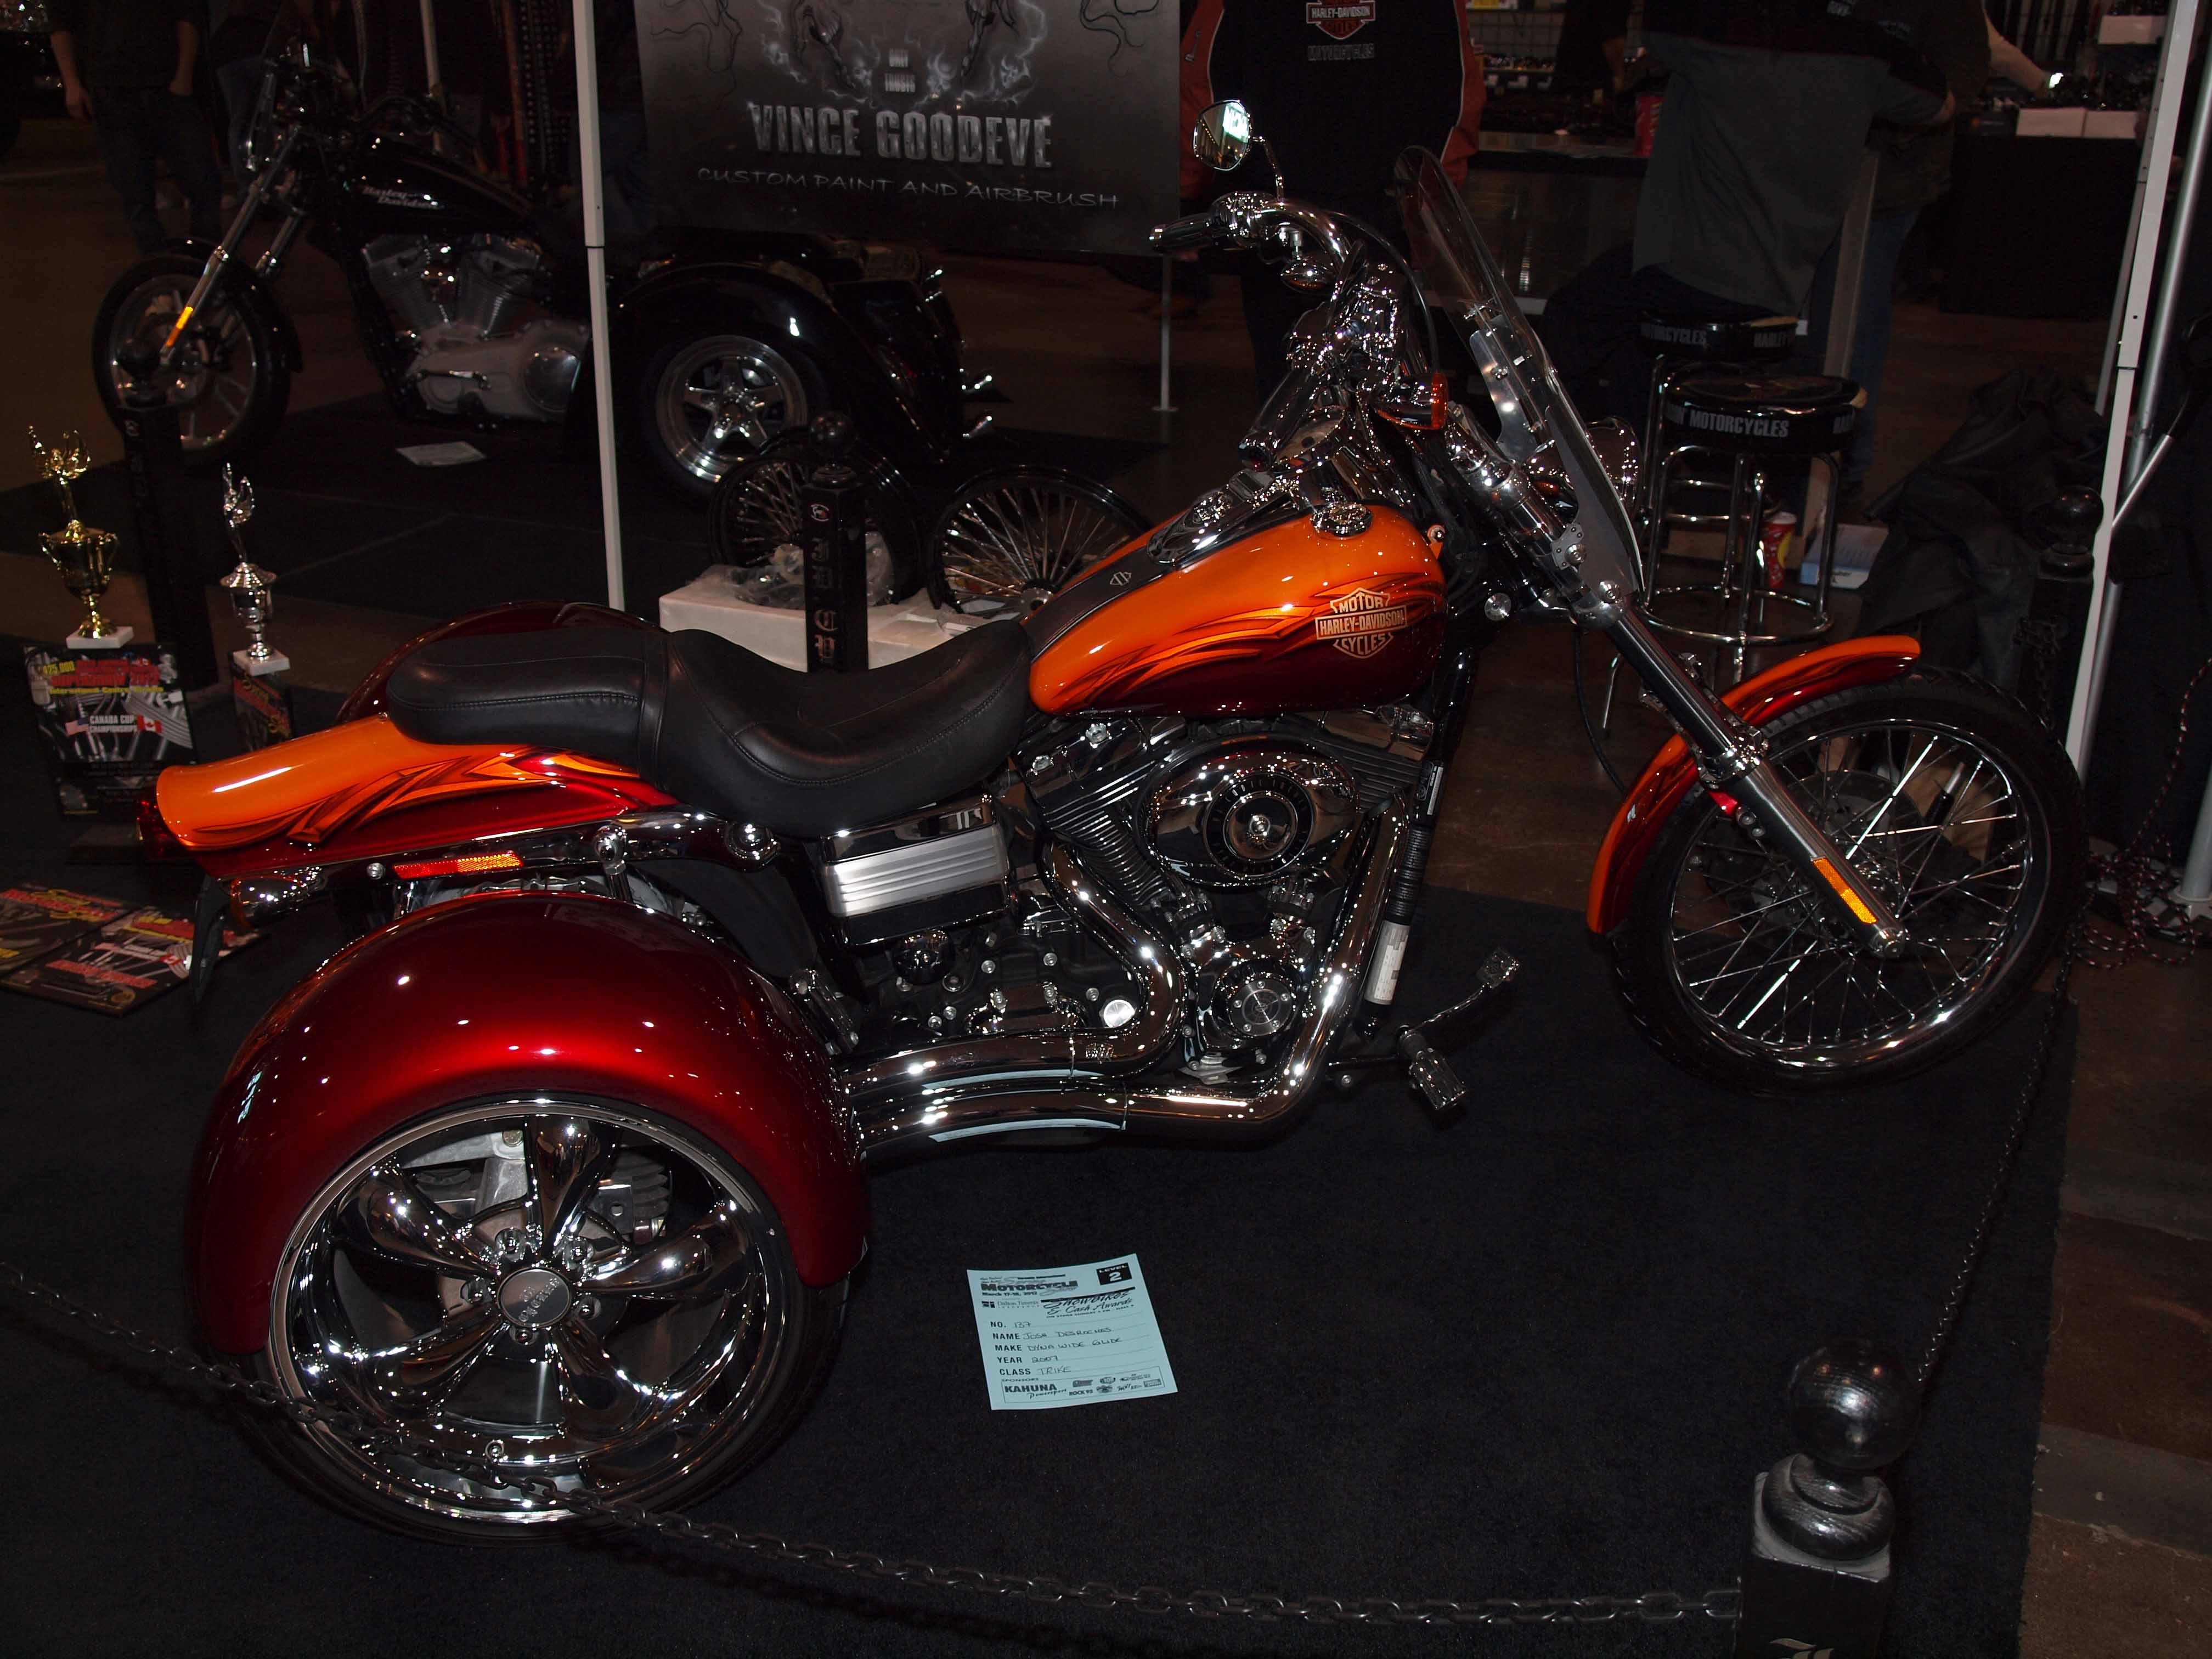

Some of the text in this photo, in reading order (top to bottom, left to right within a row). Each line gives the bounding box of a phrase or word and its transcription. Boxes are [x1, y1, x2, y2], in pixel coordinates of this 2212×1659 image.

[748, 103, 1052, 168] VINCE GOODEVE
[697, 167, 1119, 208] CUSTOM PAINT AND AIRBRUSH
[1689, 410, 1791, 438] MOTORCYCLES
[1339, 591, 1384, 613] MOTOR
[1319, 609, 1404, 636] HARLEY-DAVIDSON
[1341, 633, 1386, 655] CYCLES
[1109, 1272, 1122, 1282] 2
[1065, 1305, 1090, 1313] Cash
[1093, 1297, 1132, 1311] Awards
[1092, 1338, 1123, 1346] GLIDE
[1031, 1355, 1059, 1363] 2007
[1037, 1365, 1071, 1375] TRIKE
[1005, 1384, 1058, 1393] KAHUNA
